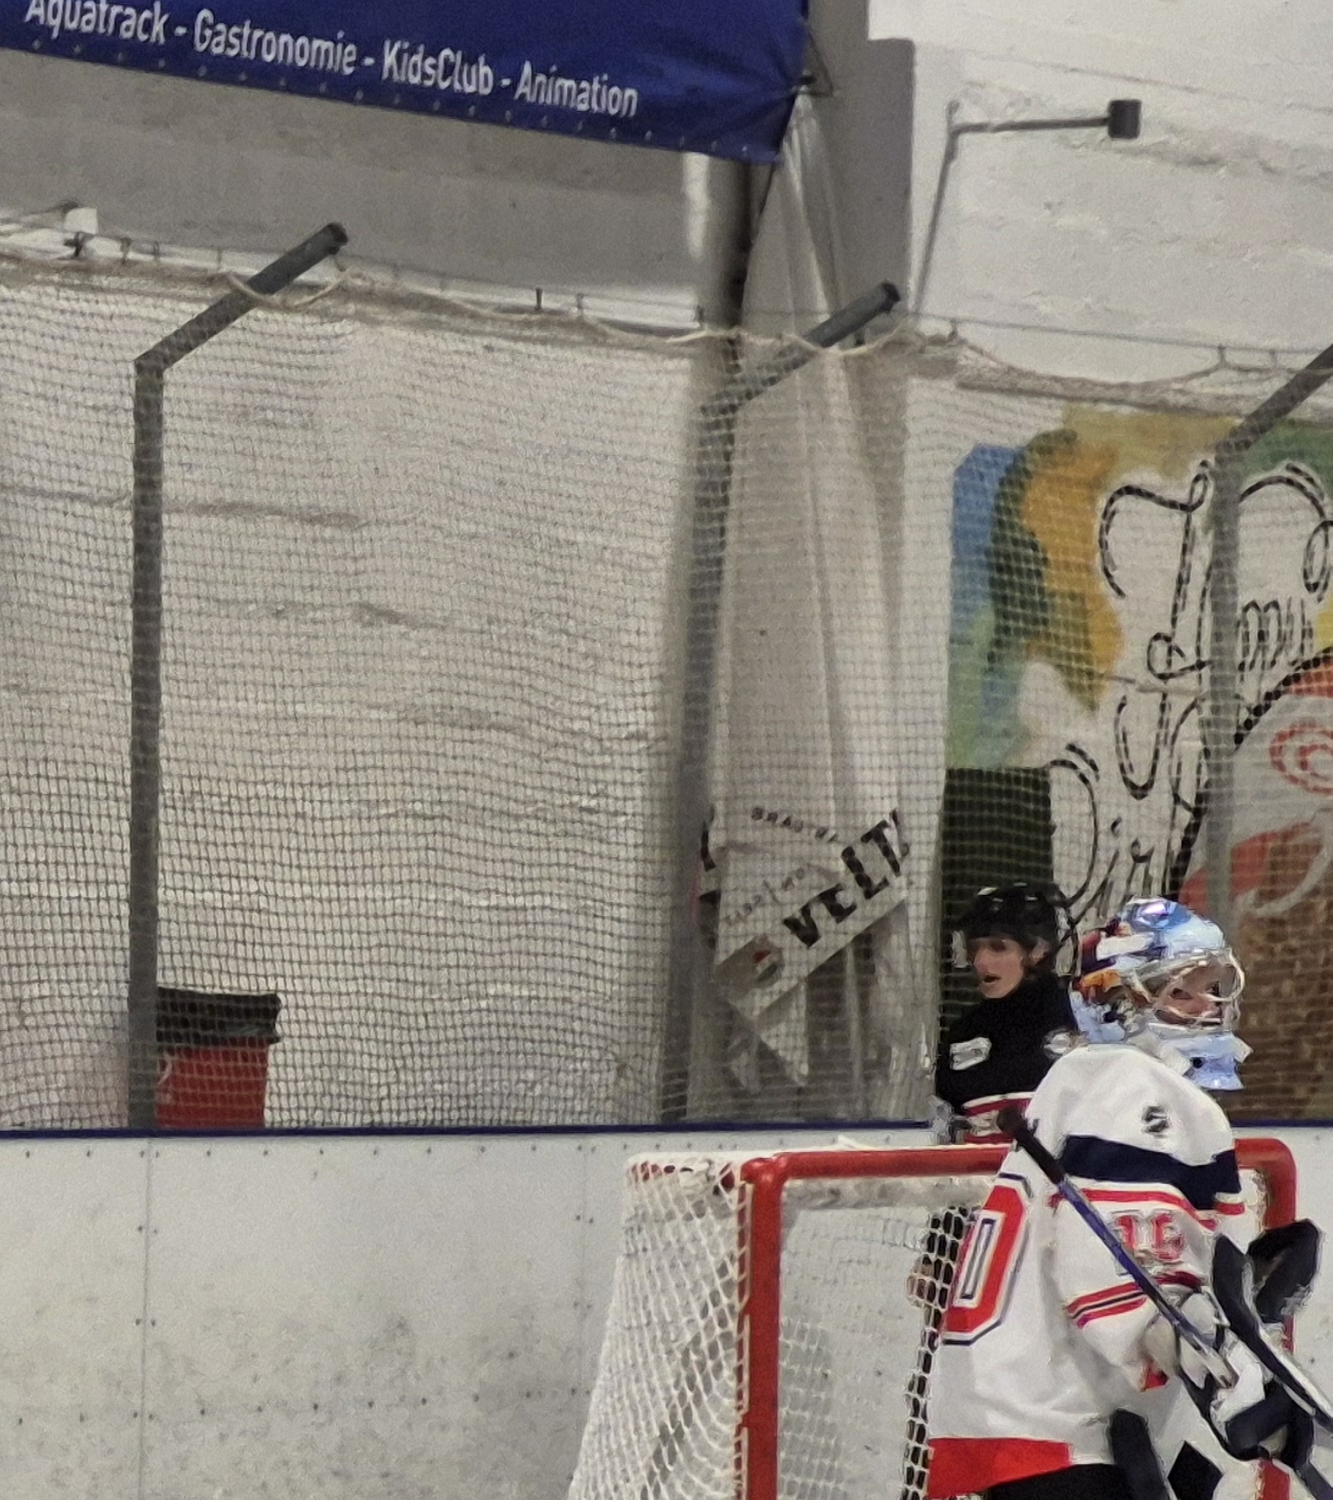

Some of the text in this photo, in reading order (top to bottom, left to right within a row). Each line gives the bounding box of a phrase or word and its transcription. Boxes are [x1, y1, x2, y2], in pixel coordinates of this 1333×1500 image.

[25, 0, 168, 43] Aquatrack
[194, 8, 358, 76] Gastronomie
[382, 41, 494, 96] KidsClub
[515, 61, 638, 118] Animation
